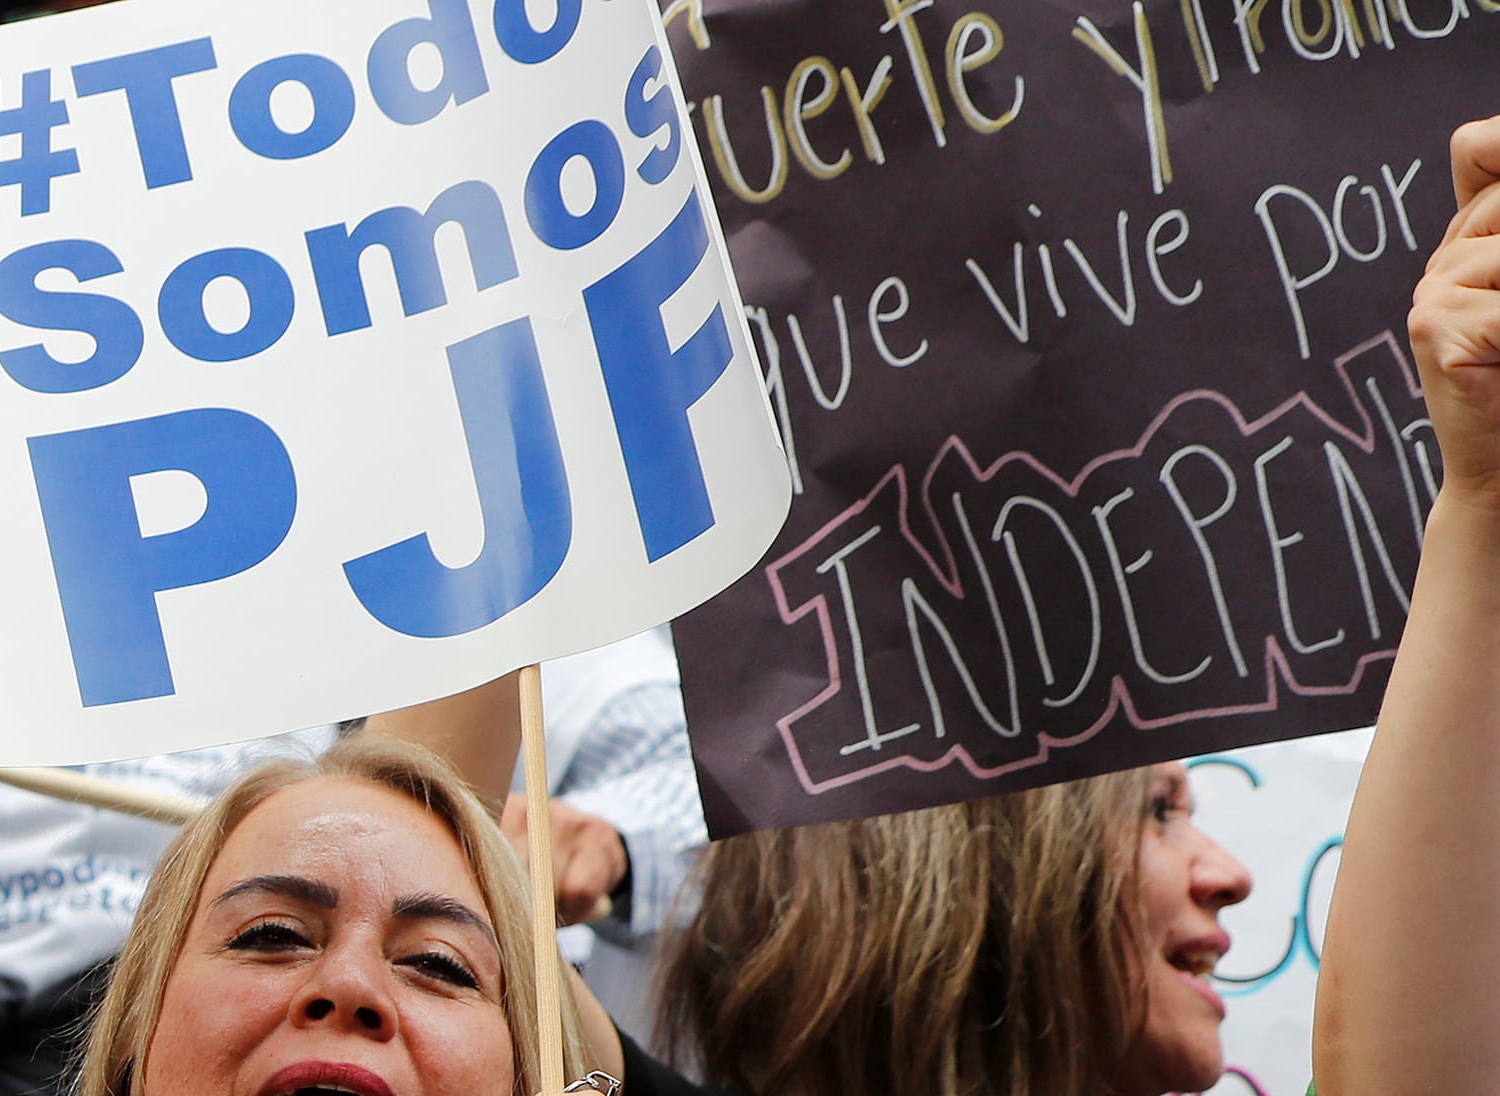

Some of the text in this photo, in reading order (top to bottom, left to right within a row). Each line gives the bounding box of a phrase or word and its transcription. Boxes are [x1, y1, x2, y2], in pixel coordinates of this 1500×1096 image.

[687, 0, 1026, 203] uerte
[1071, 0, 1172, 194] y
[967, 205, 1202, 343] vive
[1255, 158, 1422, 358] por
[26, 184, 734, 708] PJF
[817, 377, 1441, 756] INDEPEN
